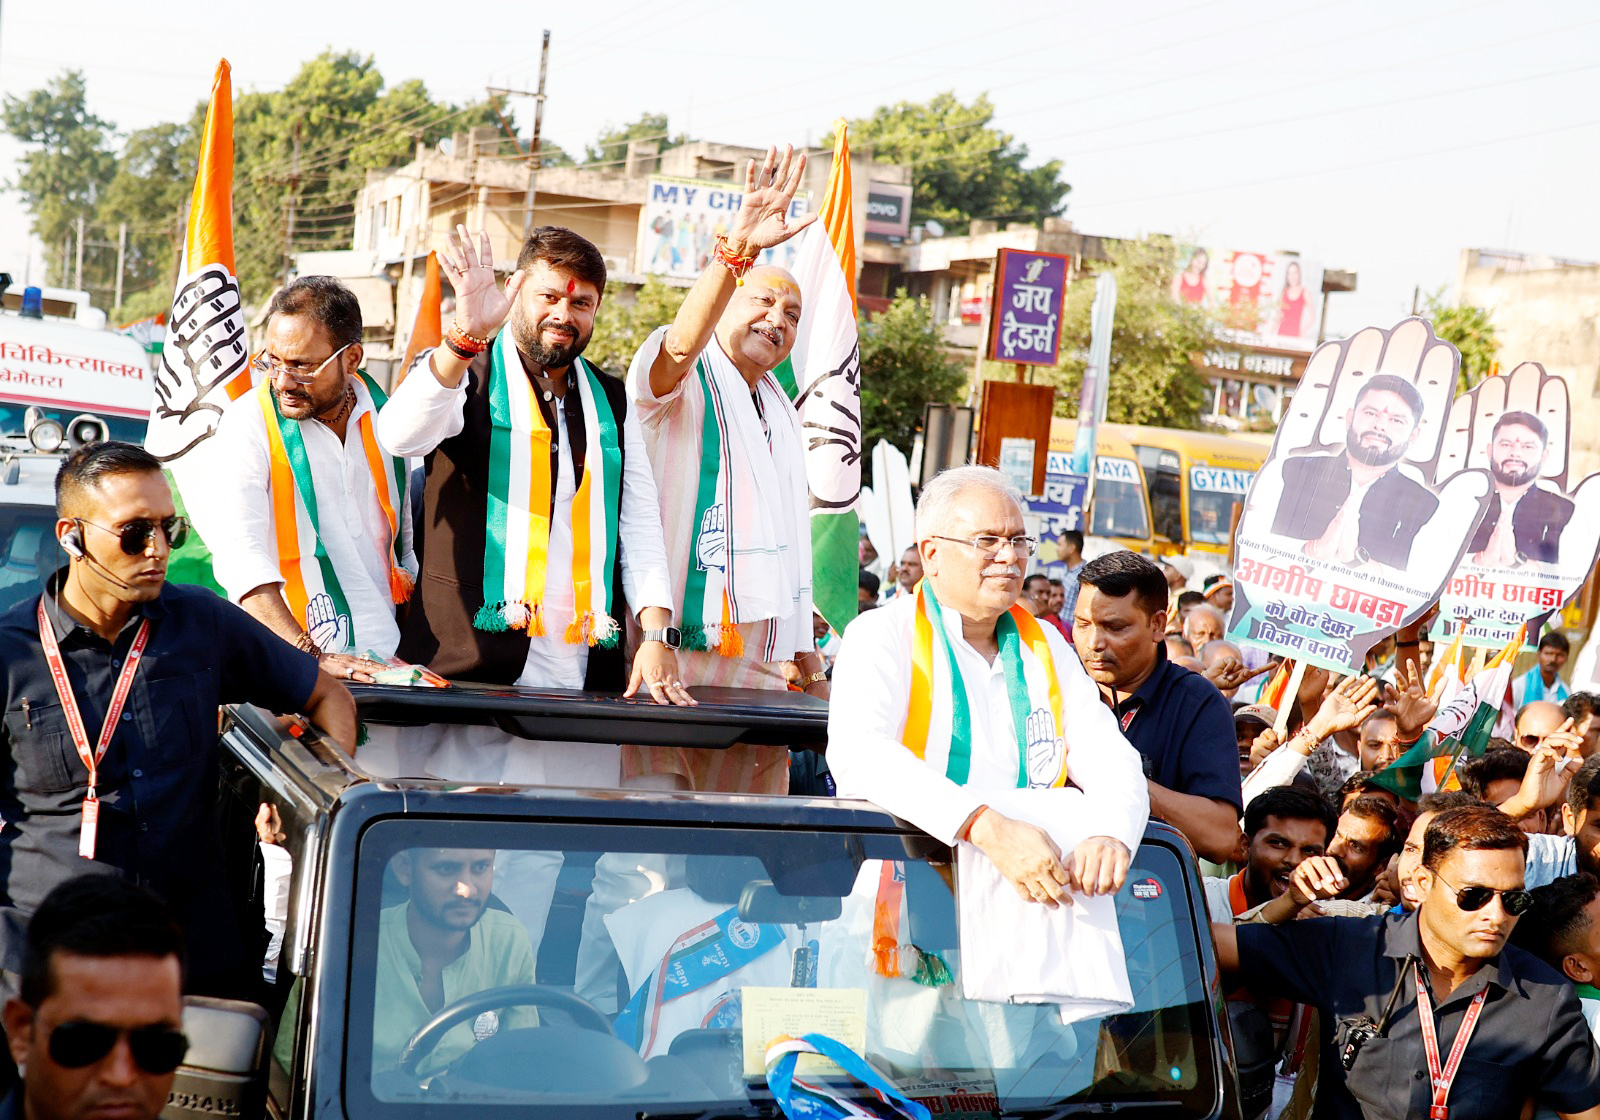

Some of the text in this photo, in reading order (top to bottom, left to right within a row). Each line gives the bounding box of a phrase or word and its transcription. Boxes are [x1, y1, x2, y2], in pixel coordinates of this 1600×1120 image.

[653, 184, 697, 205] MY
[1012, 283, 1053, 314] जय
[1002, 310, 1057, 357] ट्रेडर्स
[1, 342, 143, 380] चिकित्सालय
[1236, 557, 1408, 628] आशीष छाबड़ा
[1502, 583, 1565, 611] छाबड़ा
[1265, 599, 1355, 638] को वोट देकर
[1453, 603, 1526, 623] को वोट देकर
[1259, 622, 1305, 649] विजय
